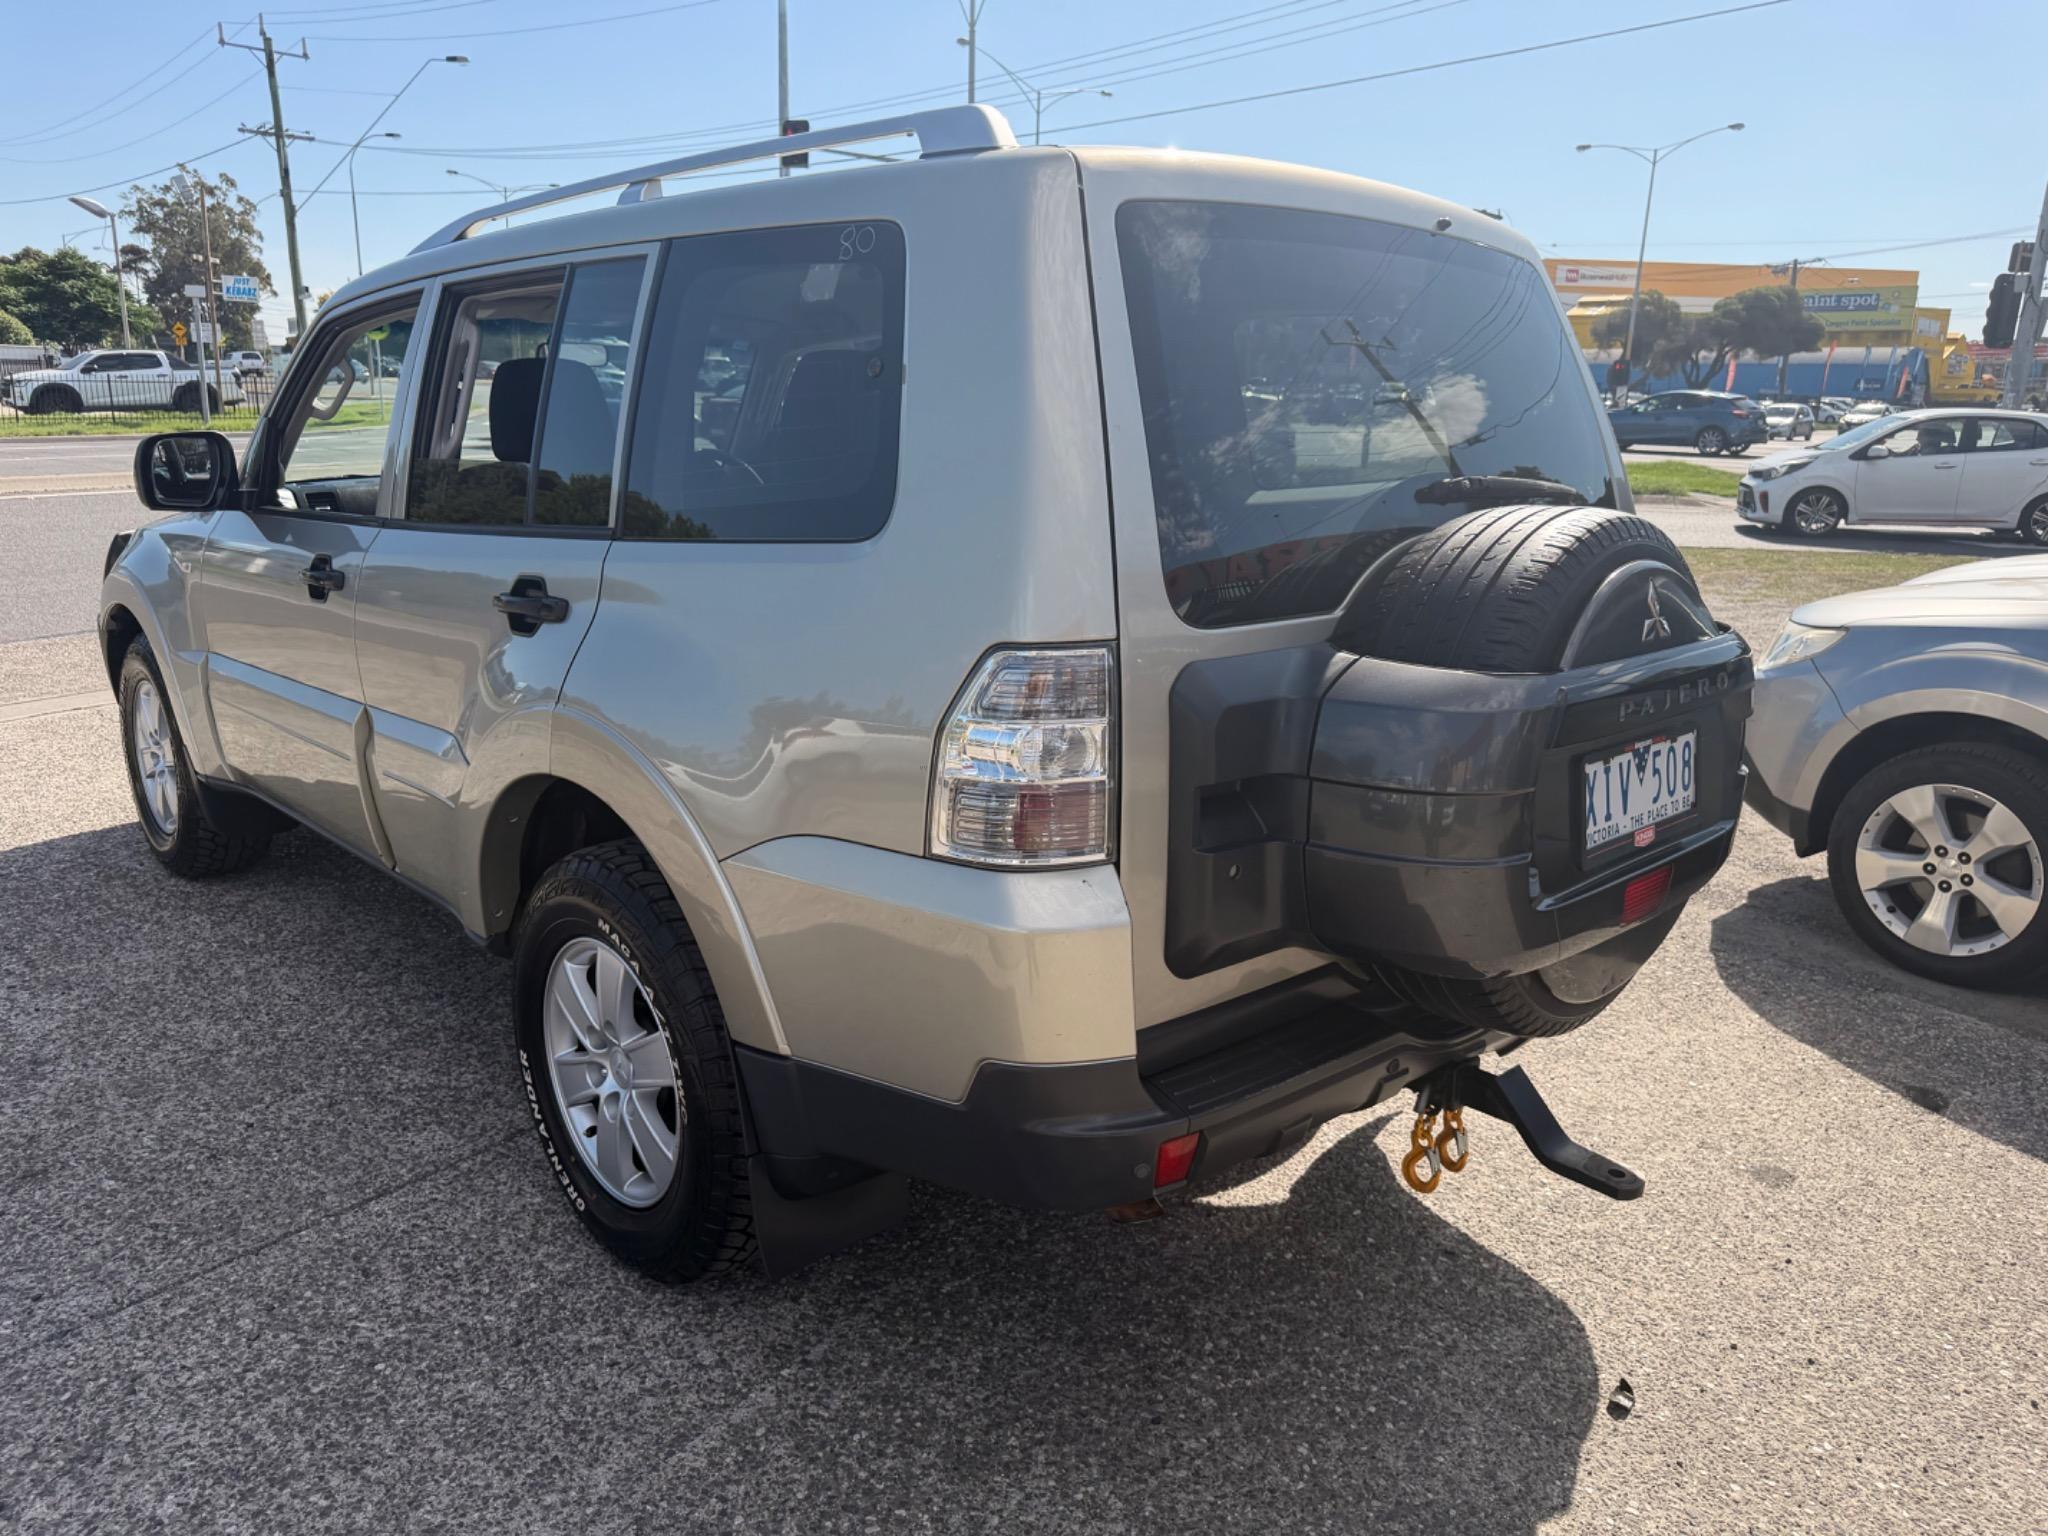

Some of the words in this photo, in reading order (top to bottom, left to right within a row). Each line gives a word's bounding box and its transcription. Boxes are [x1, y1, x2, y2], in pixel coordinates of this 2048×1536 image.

[838, 224, 876, 261] 80
[233, 277, 250, 285] JUST
[1803, 293, 1838, 307] aint
[1840, 293, 1878, 310] spot
[1618, 671, 1729, 722] PAJERO
[1586, 759, 1632, 827] XIV
[1651, 740, 1692, 805] 508
[1630, 812, 1645, 830] THE
[1647, 803, 1668, 822] PLACE
[1671, 799, 1680, 813] TO
[520, 1049, 586, 1212] GRENLANDER
